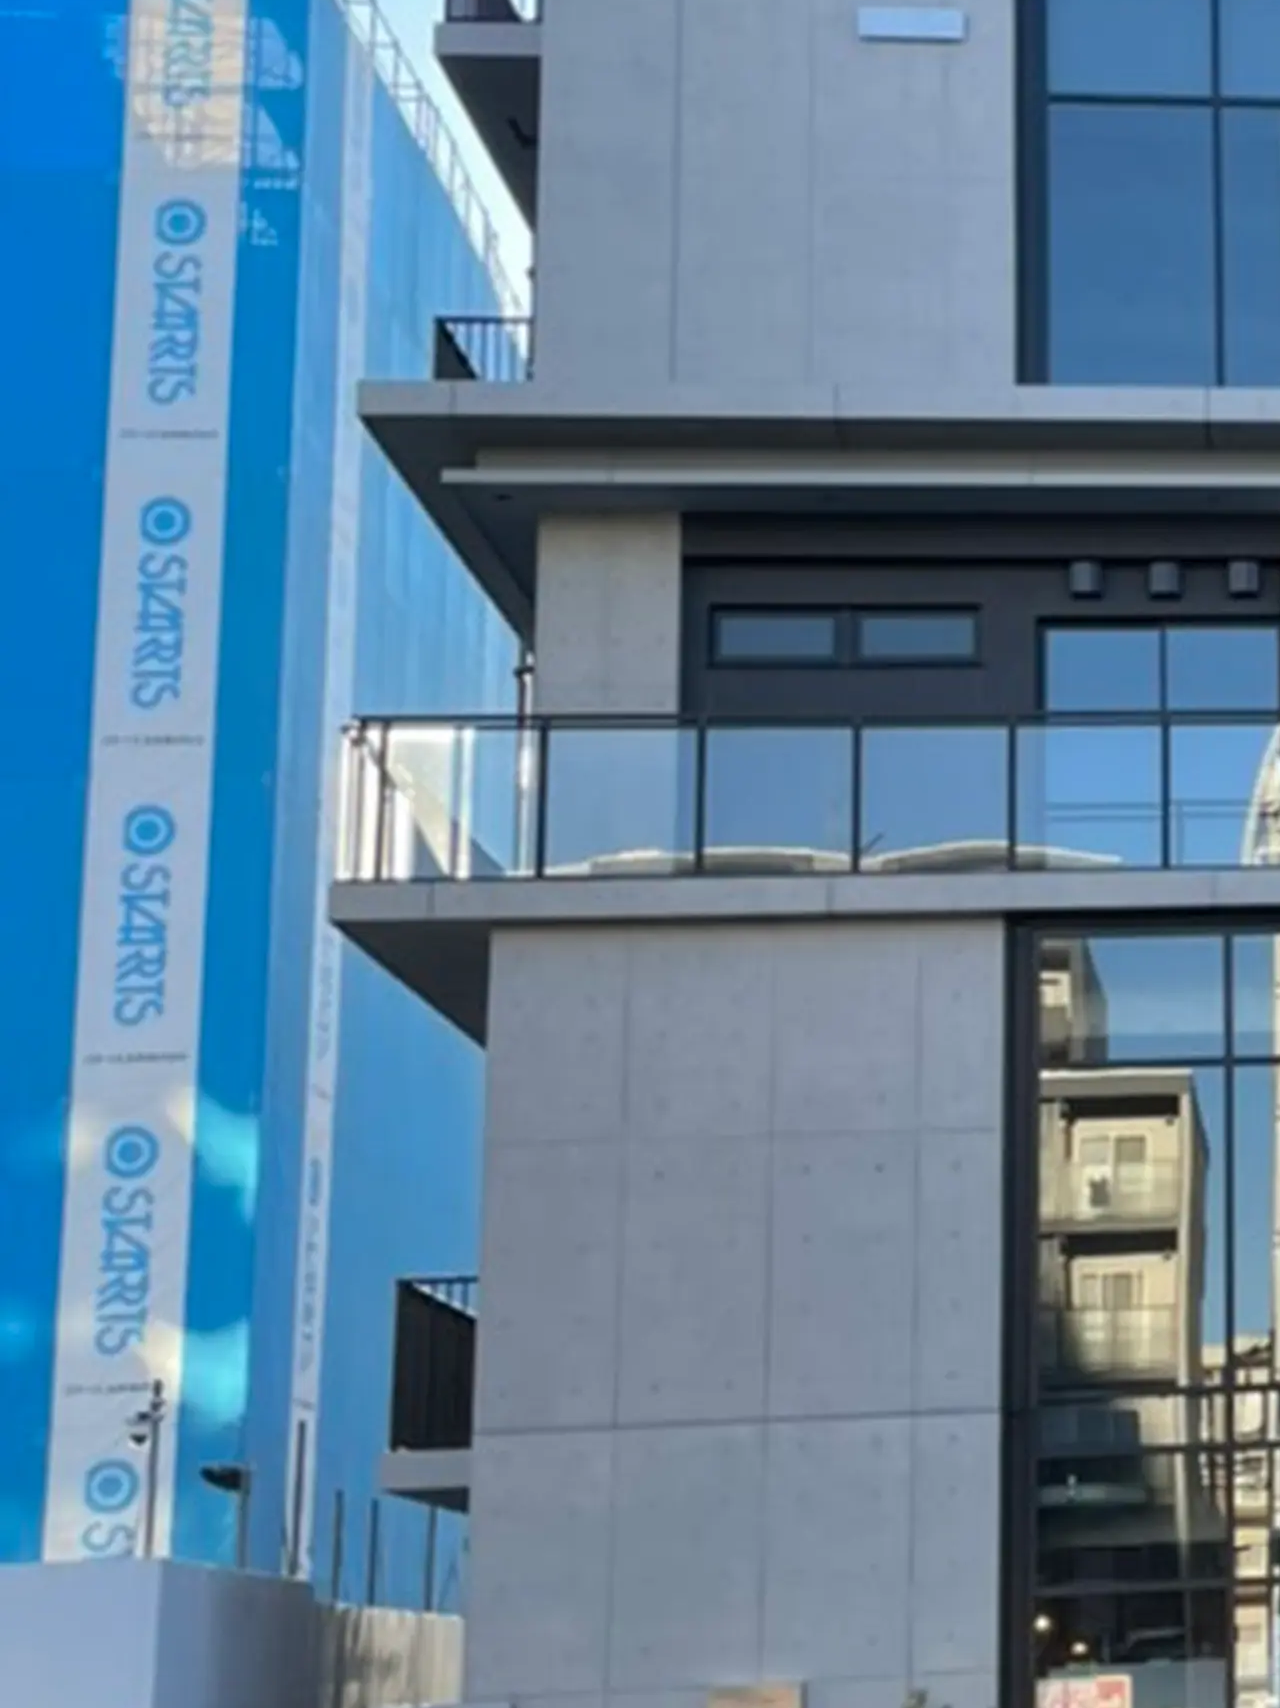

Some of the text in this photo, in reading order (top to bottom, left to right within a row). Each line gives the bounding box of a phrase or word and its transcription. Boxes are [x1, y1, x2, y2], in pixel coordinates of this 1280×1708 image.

[148, 250, 202, 405] STARTS
[131, 551, 188, 709] STARTS
[114, 862, 171, 1026] STARTS
[95, 1185, 154, 1357] STARTS
